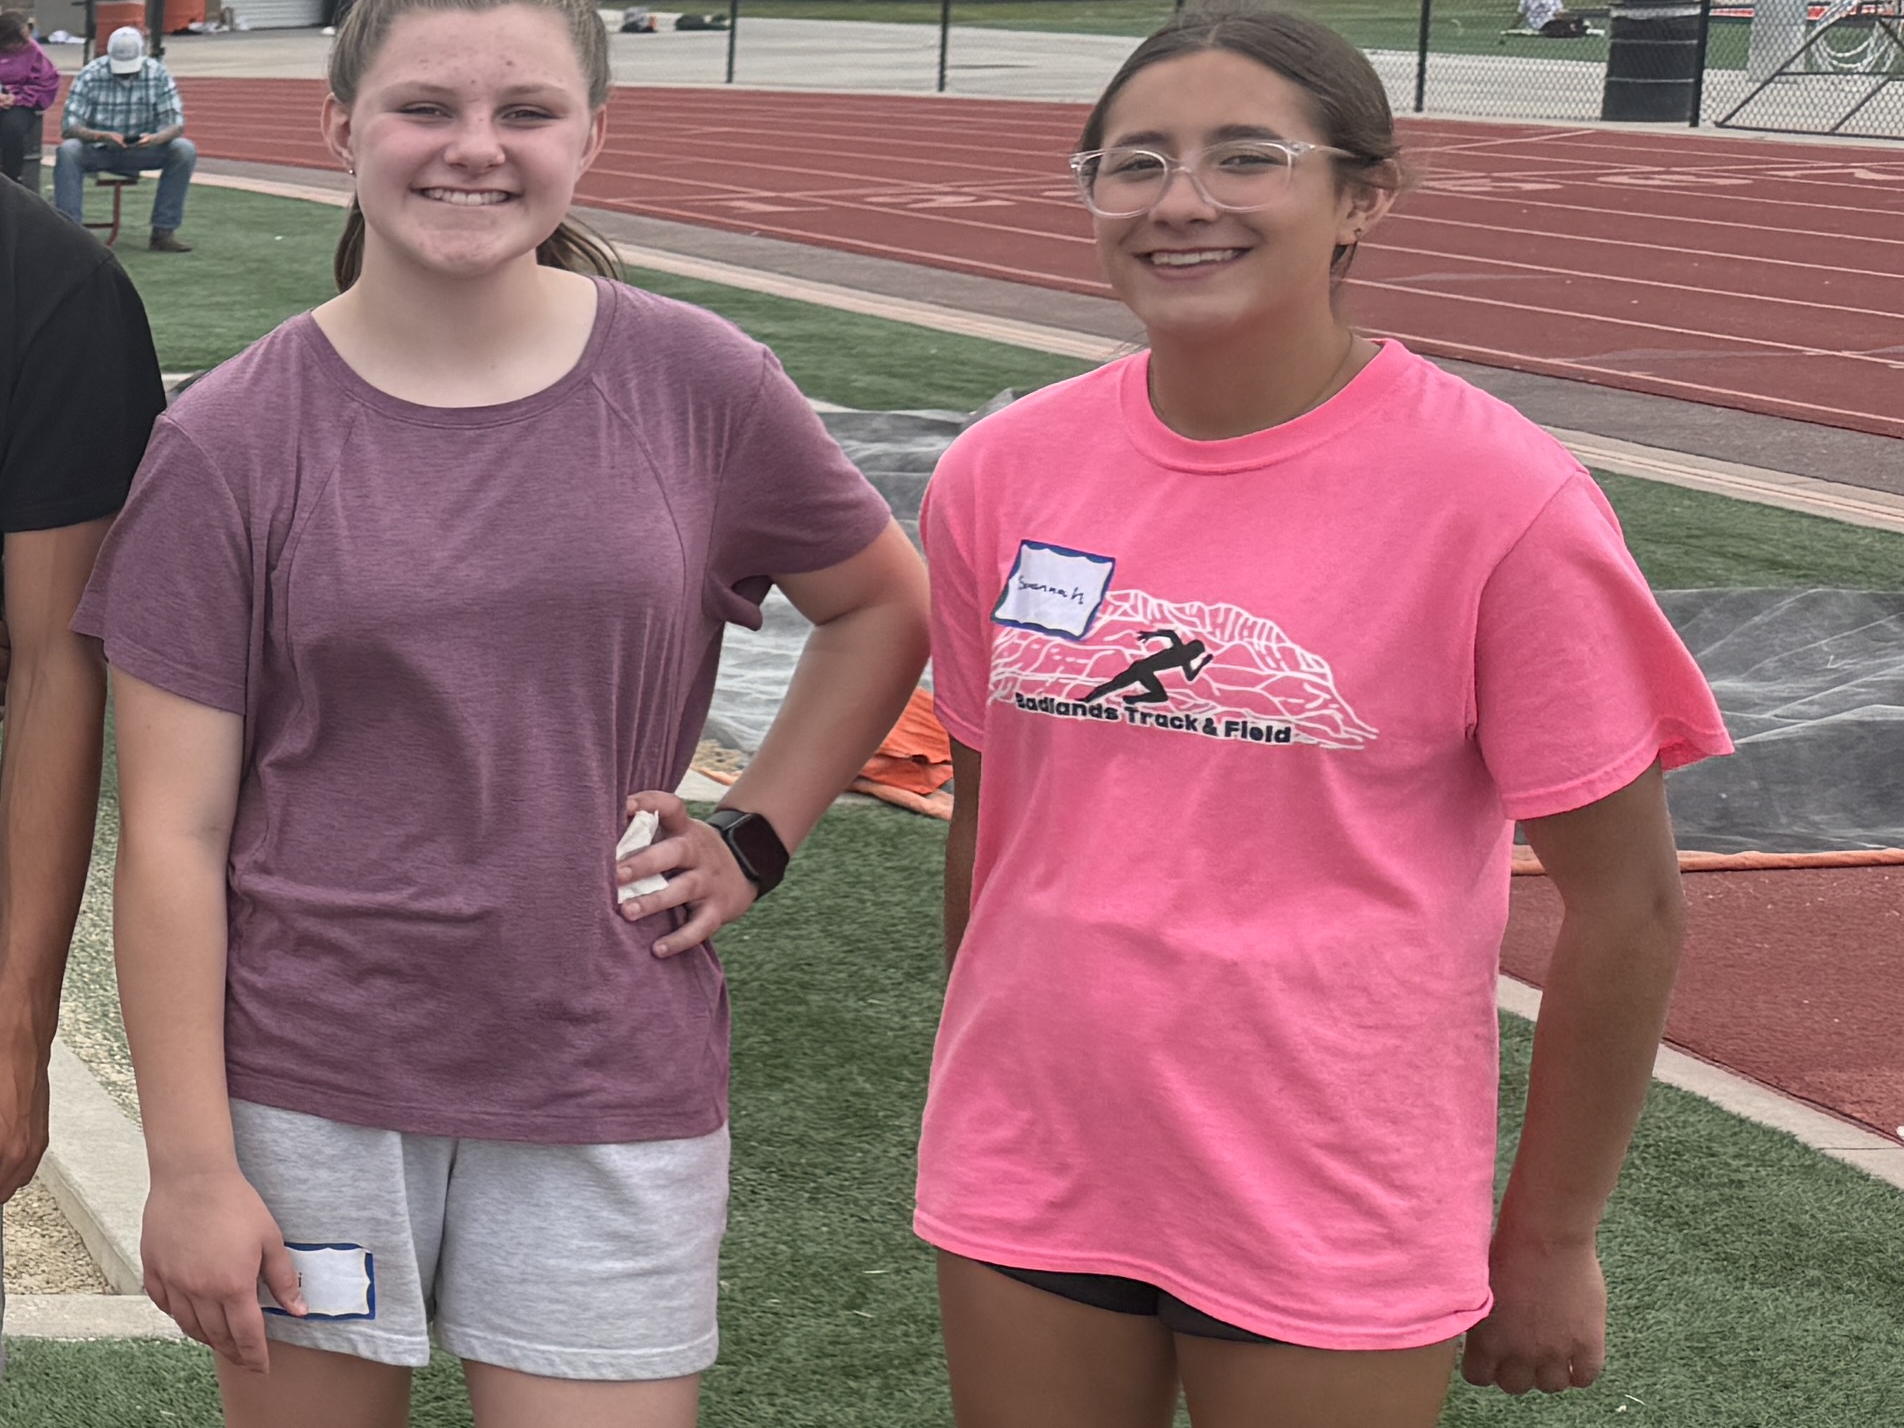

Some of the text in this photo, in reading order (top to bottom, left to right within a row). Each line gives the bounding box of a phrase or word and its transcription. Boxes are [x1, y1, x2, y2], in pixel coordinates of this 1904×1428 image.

[1014, 691, 1292, 744] Badlands Track & Field
